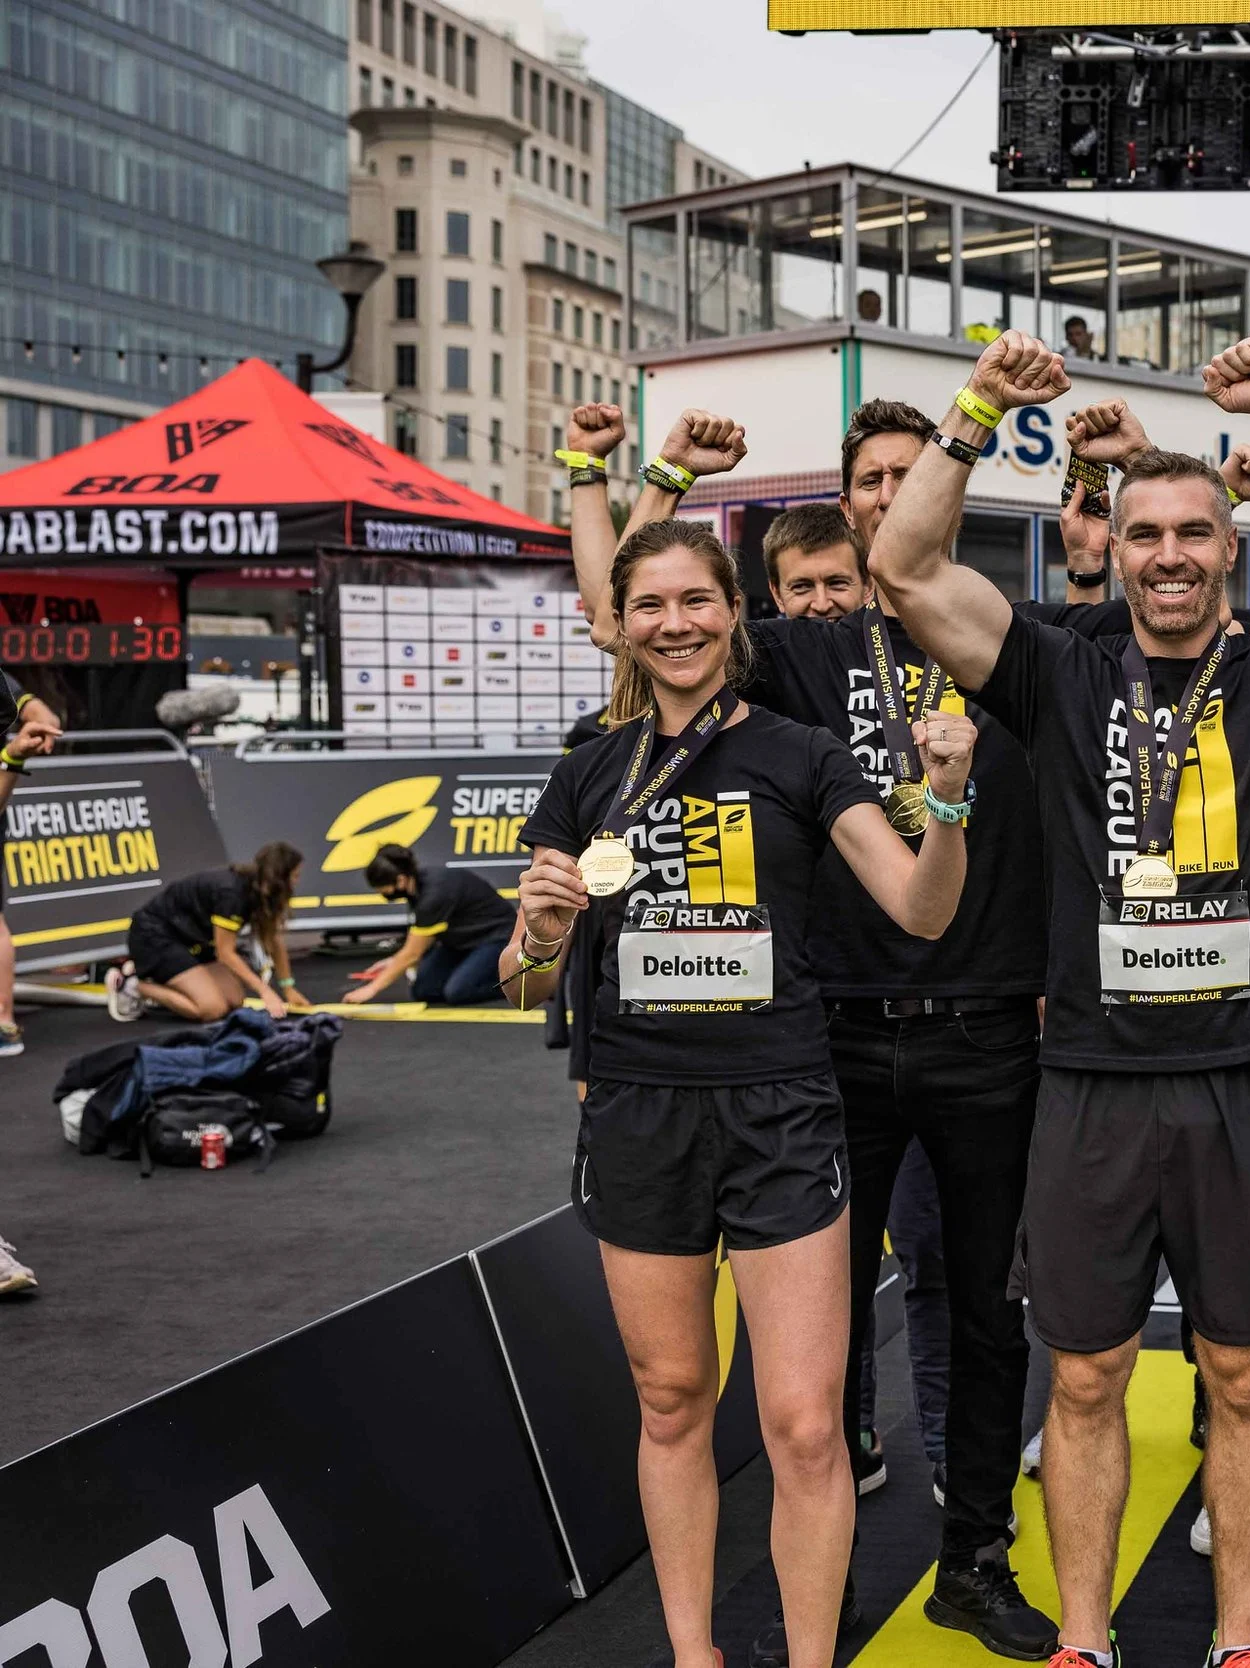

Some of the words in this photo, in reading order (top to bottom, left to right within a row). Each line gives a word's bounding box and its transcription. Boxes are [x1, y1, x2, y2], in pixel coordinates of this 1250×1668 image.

[62, 474, 221, 496] BOA
[0, 509, 279, 554] ABLAST.COM
[45, 596, 102, 624] BOA
[871, 623, 898, 720] #IAMSUPERLEAGUE
[624, 748, 689, 816] #IAMSUPERLEAGUE
[7, 802, 67, 839] UPER
[67, 796, 151, 834] LEAGUE
[4, 829, 160, 888] TRIATHLON
[1179, 863, 1203, 873] BIKE
[1212, 861, 1234, 870] RUN
[676, 909, 750, 926] RELAY
[1155, 900, 1229, 921] RELAY
[643, 955, 748, 976] Deloitte.
[1122, 948, 1226, 969] Deloitte.
[646, 1002, 743, 1012] #IAMSUPERLEAGUE
[1129, 991, 1222, 1003] #IAMSUPERLEAGUE
